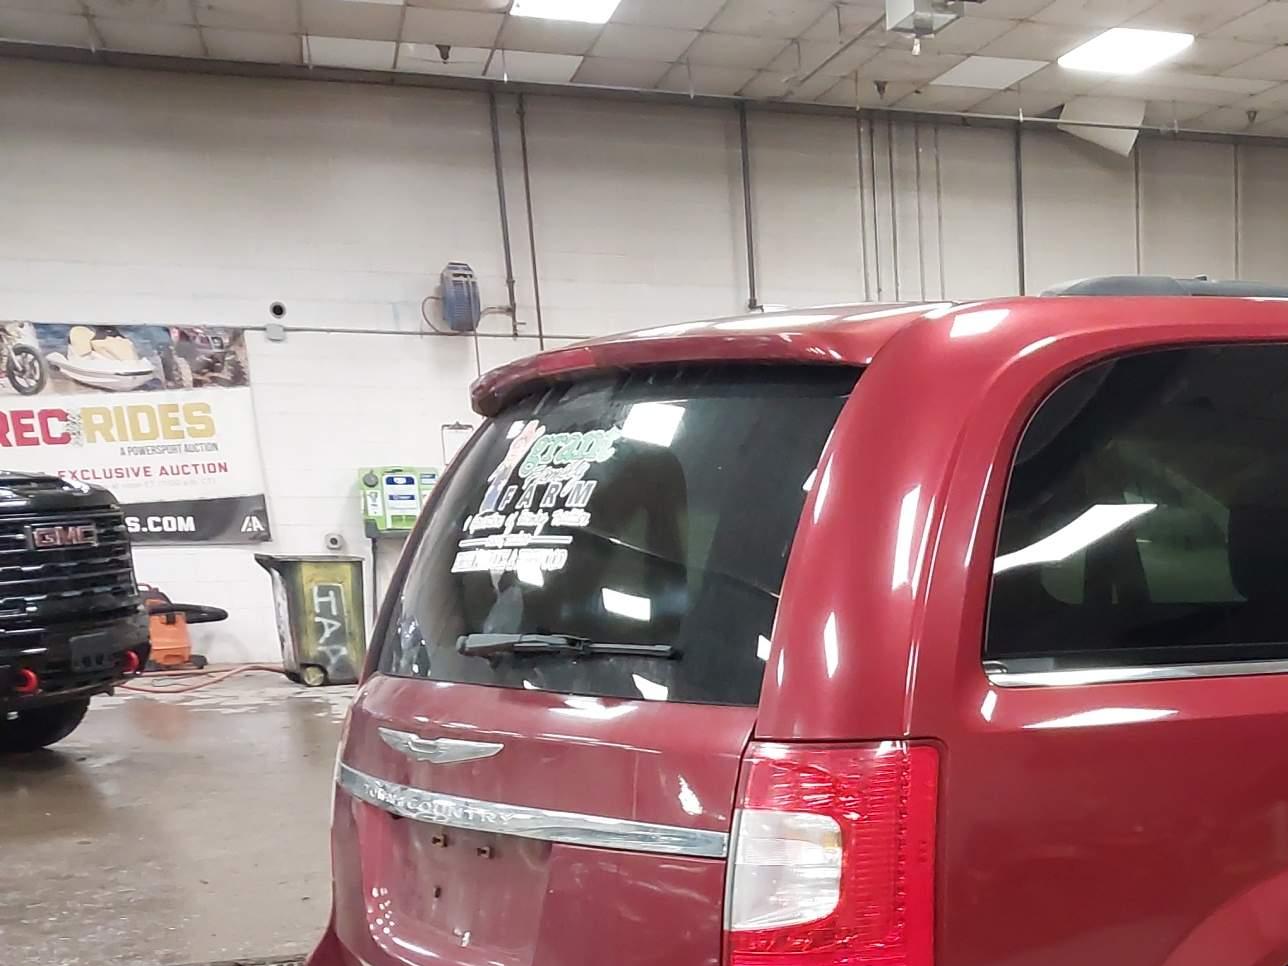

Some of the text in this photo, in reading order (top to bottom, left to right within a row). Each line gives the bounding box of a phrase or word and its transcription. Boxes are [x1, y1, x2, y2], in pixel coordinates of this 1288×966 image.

[80, 402, 216, 443] RIDES
[184, 442, 218, 453] AUCTION
[57, 462, 228, 481] EXCLUSIVE AUCTION
[497, 480, 597, 512] FARM
[33, 526, 97, 547] GMC
